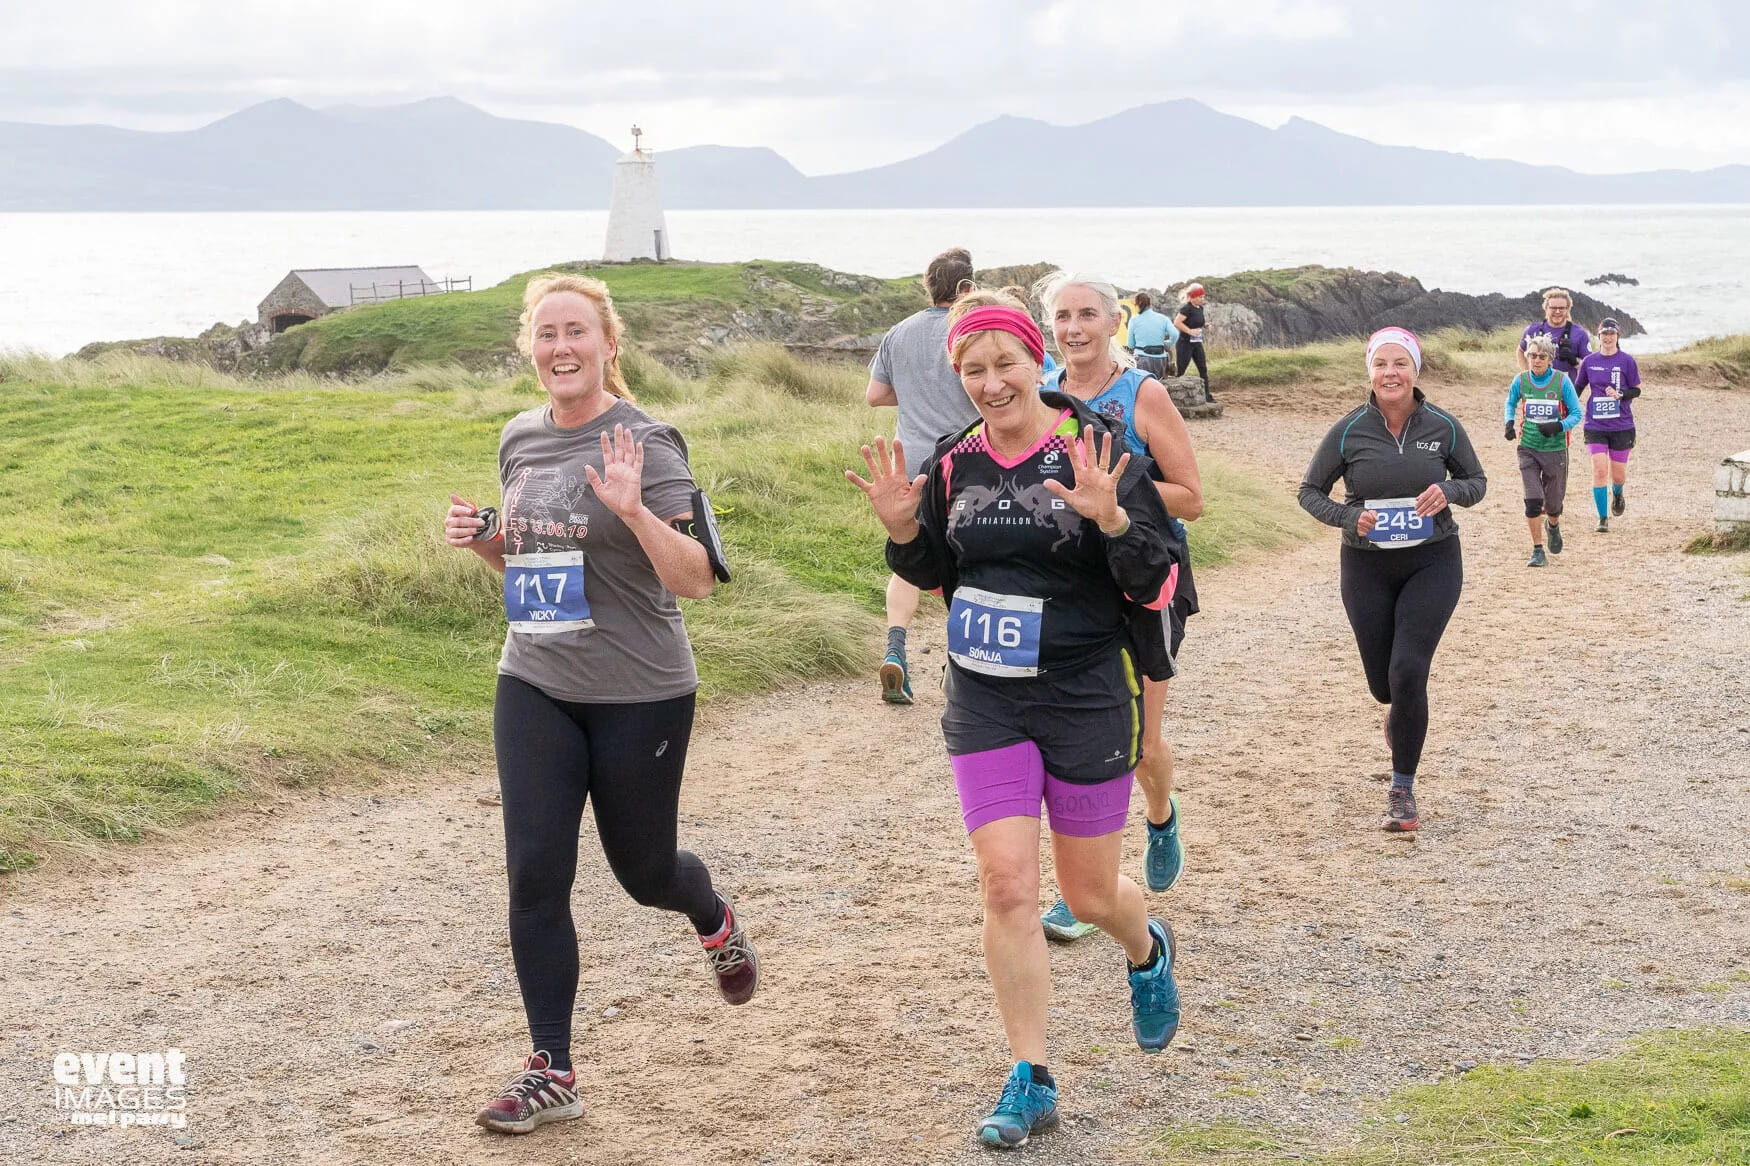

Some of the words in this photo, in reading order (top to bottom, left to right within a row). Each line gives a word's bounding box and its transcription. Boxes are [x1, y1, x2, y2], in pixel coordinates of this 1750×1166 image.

[1529, 405, 1553, 416] 298
[1596, 401, 1616, 412] 222
[976, 517, 1031, 525] TRIATHLON
[1374, 510, 1423, 531] 245
[514, 572, 567, 605] 117
[529, 609, 557, 621] VICKY
[960, 607, 1022, 648] 116
[968, 646, 1003, 664] SONJA
